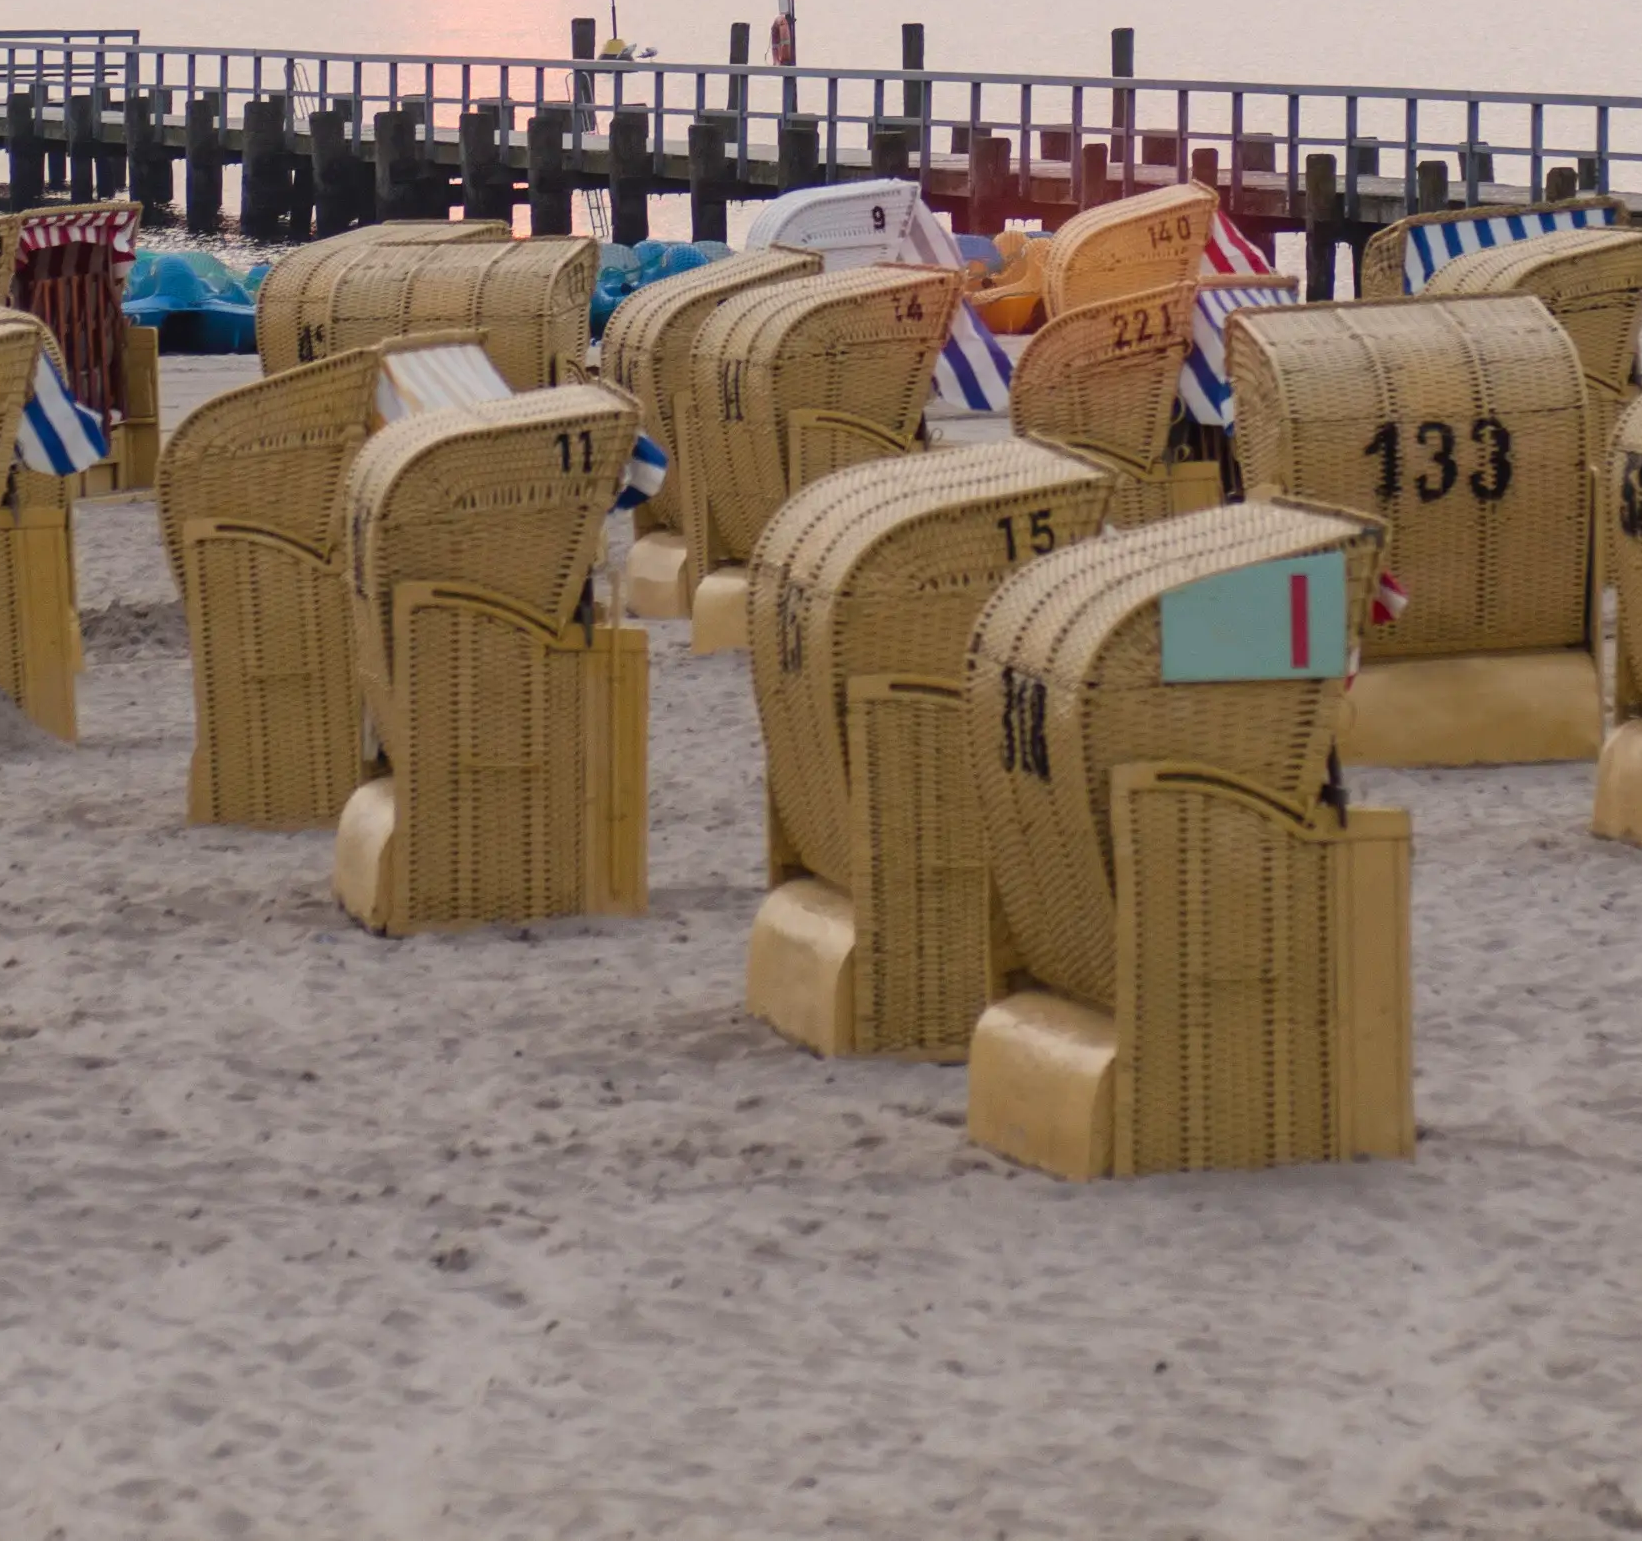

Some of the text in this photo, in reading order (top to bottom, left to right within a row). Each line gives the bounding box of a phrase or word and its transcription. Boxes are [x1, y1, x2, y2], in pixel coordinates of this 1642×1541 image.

[871, 206, 886, 230] 9
[1149, 216, 1191, 249] 140
[1112, 305, 1173, 350] 221
[556, 430, 593, 474] 11
[1364, 415, 1512, 503] 133
[997, 509, 1055, 562] 15
[1290, 574, 1309, 669] I
